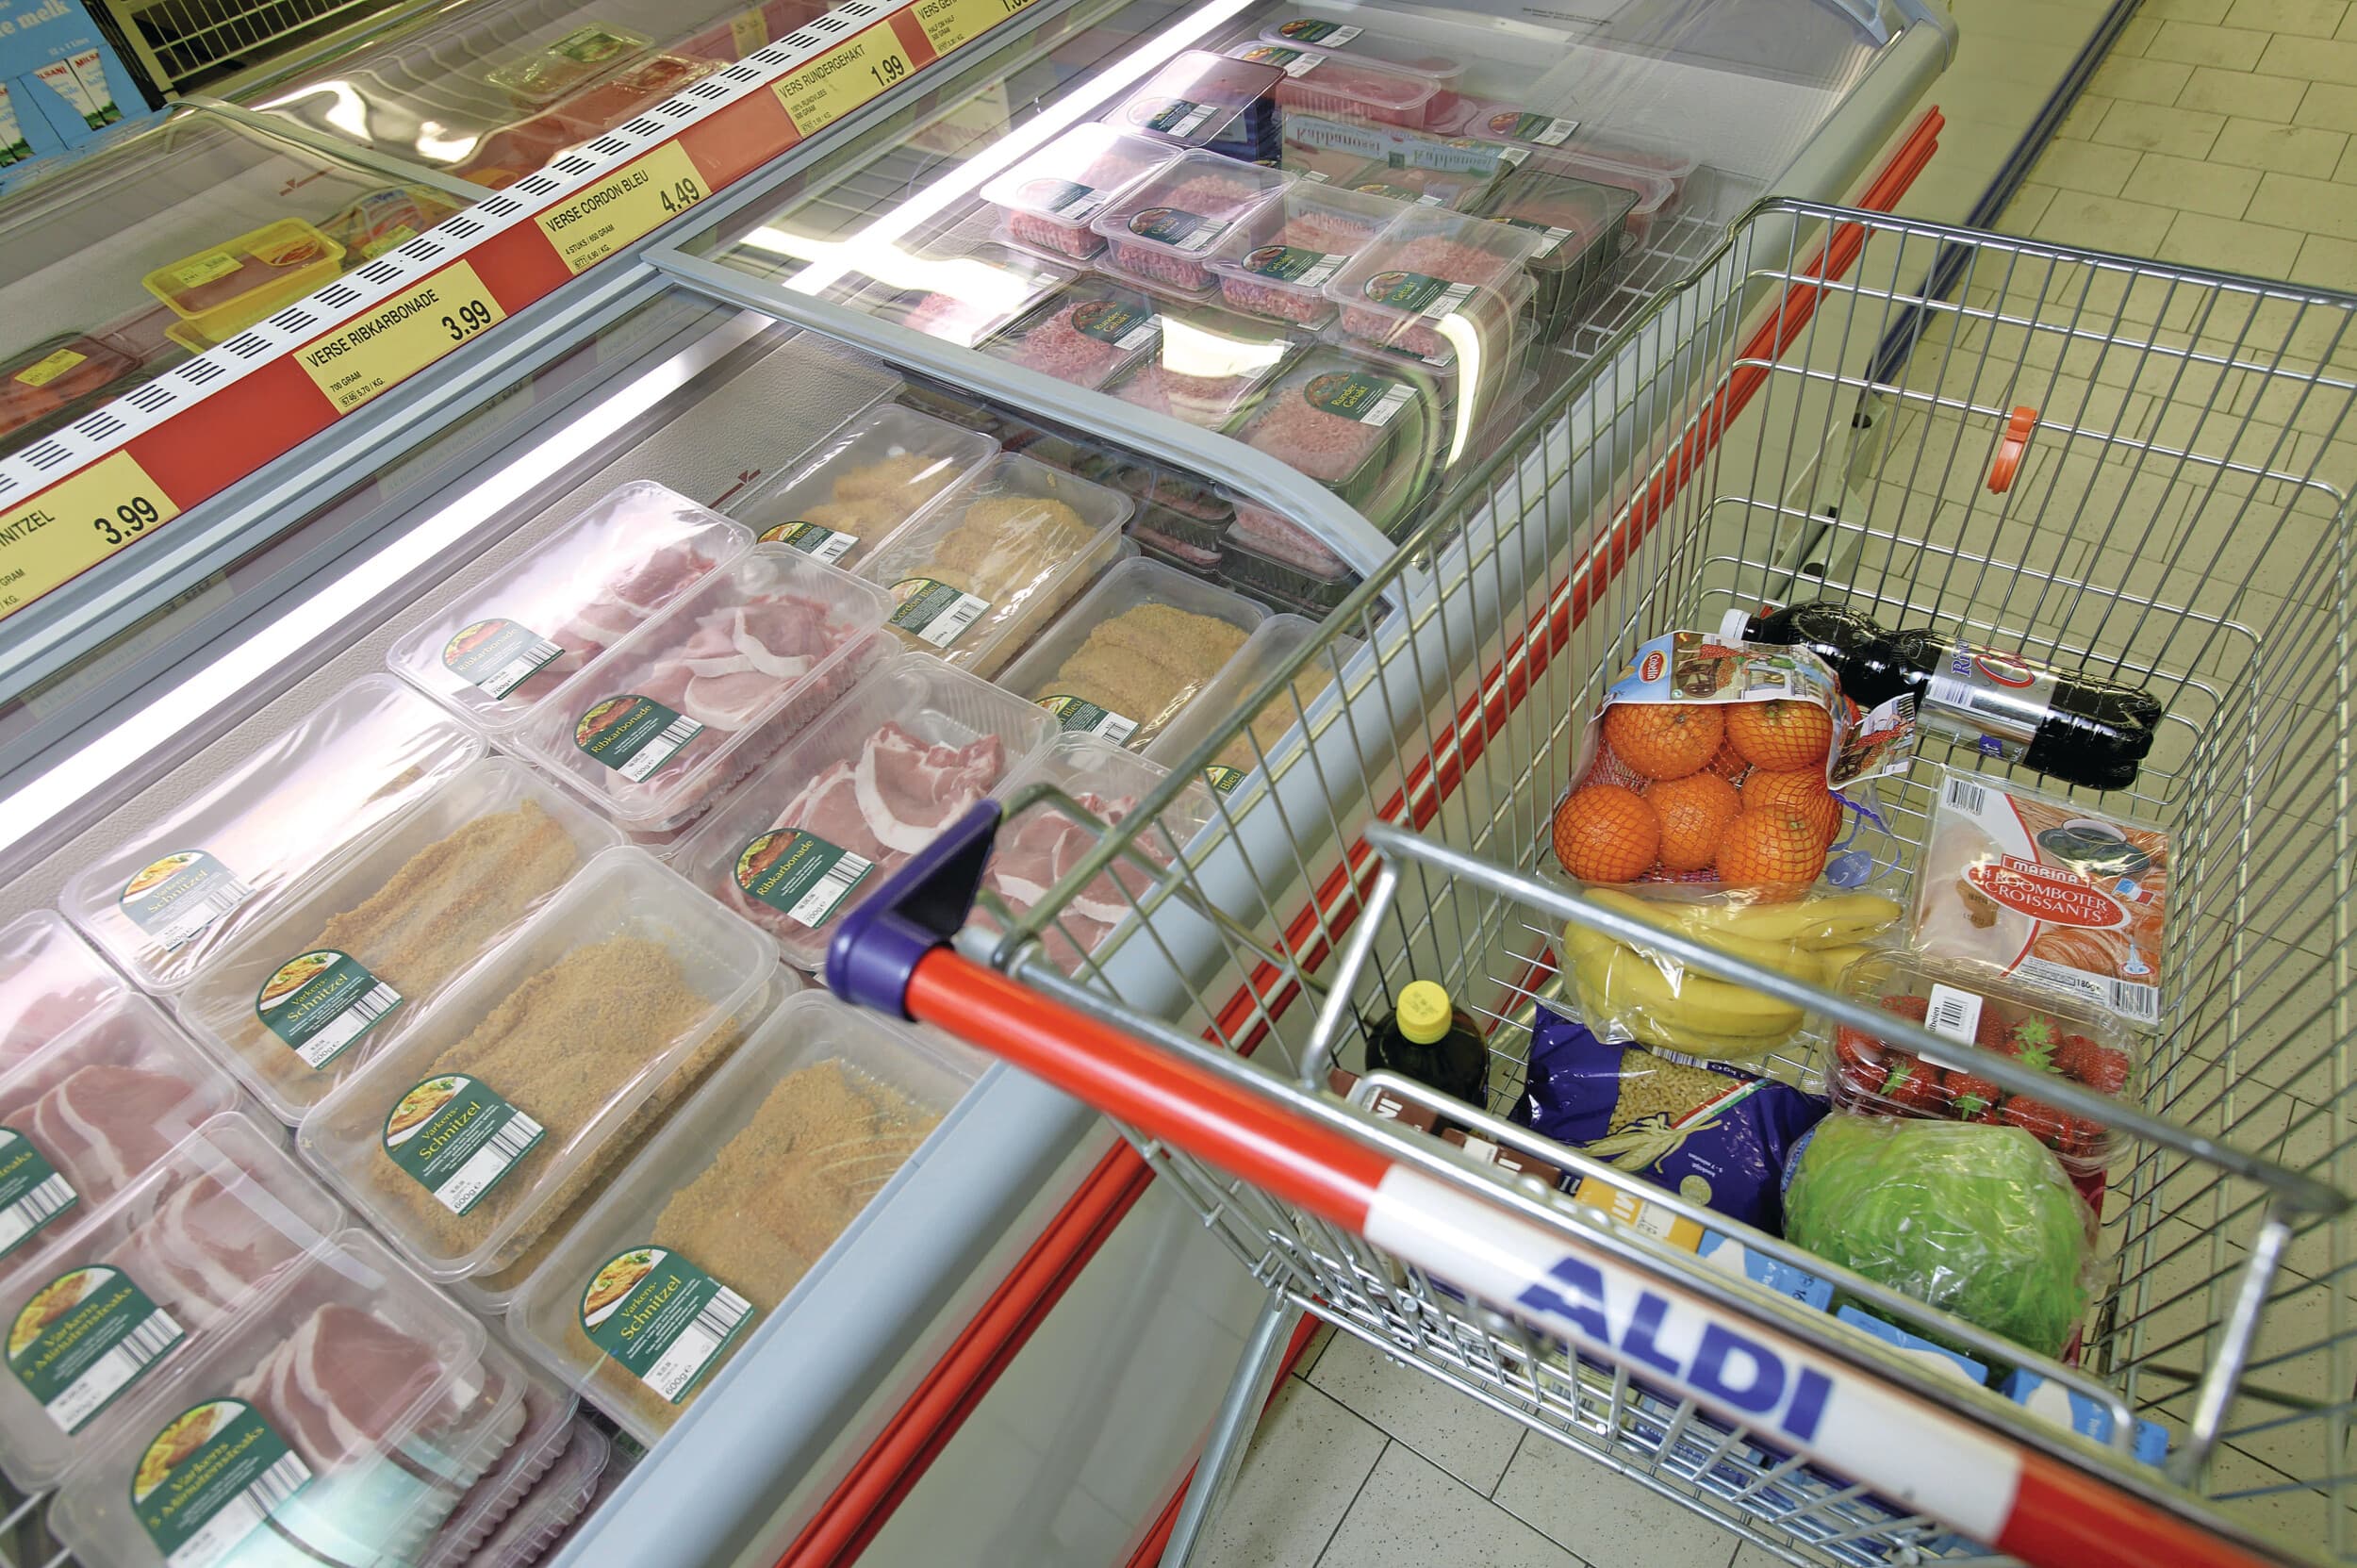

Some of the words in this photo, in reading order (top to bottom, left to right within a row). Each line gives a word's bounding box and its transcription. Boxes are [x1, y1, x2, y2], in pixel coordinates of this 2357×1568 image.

[16, 0, 72, 29] melk
[918, 2, 939, 20] VERS
[779, 79, 803, 98] VERS
[801, 43, 865, 87] RUNDERGEHAKT
[871, 55, 904, 87] 1.99
[546, 206, 583, 233] VERSE
[581, 184, 623, 215] CORDON
[622, 170, 650, 191] BLEU
[660, 177, 700, 213] 4.49
[569, 239, 587, 255] STUKS
[598, 224, 615, 238] GRAM
[306, 338, 351, 368] VERSE
[347, 289, 439, 347] RIBKARBONADE
[441, 300, 491, 341] 3.99
[330, 379, 343, 392] 700
[341, 371, 362, 387] GRAM
[0, 509, 56, 550] NITZEL
[93, 497, 158, 545] 3.99
[0, 569, 25, 587] GRAM
[920, 583, 940, 598] Bleu
[458, 628, 519, 671] Ribkarbonade
[1646, 653, 1660, 680] Cobella
[591, 704, 653, 753] Ribkarbonade
[1063, 701, 1083, 717] Bleu
[1220, 772, 1241, 790] Bleu
[756, 839, 815, 896] Ribkarbonade
[148, 869, 208, 913] Schnitzel
[1984, 881, 2102, 923] CROISSANTS
[1995, 870, 2108, 913] ROOMBOTER
[287, 973, 348, 1022] Schnitzel
[1928, 1006, 1940, 1032] dbeien
[419, 1101, 481, 1160] Schnitzel
[421, 1107, 459, 1140] Varkens-
[453, 1187, 477, 1210] 600g
[620, 1281, 657, 1318] Varkens-
[620, 1274, 683, 1341] Schnitzel
[1514, 1255, 1834, 1445] ALDI
[665, 1369, 689, 1395] 600g
